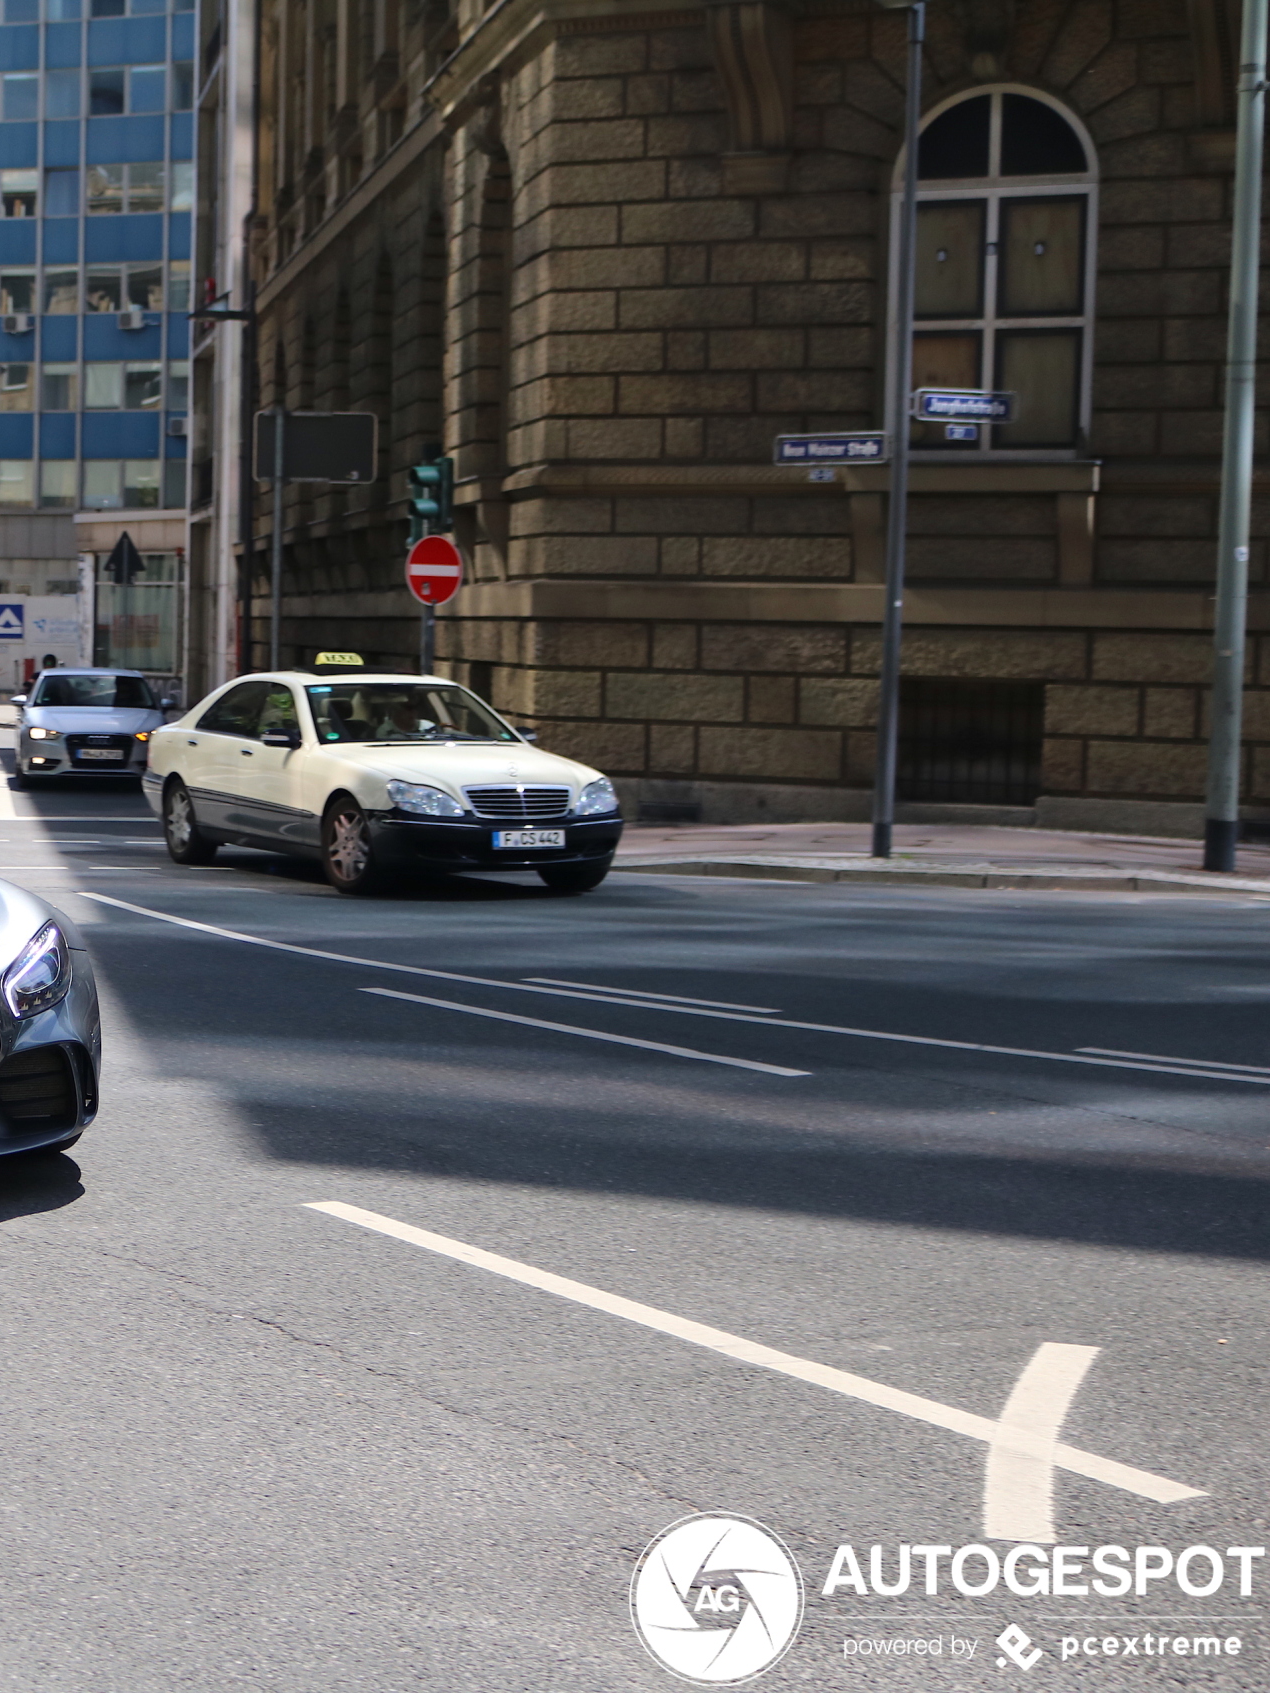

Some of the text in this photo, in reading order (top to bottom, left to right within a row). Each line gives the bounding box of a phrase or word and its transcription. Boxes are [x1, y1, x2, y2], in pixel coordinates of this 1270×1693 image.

[504, 832, 560, 845] F CS 442
